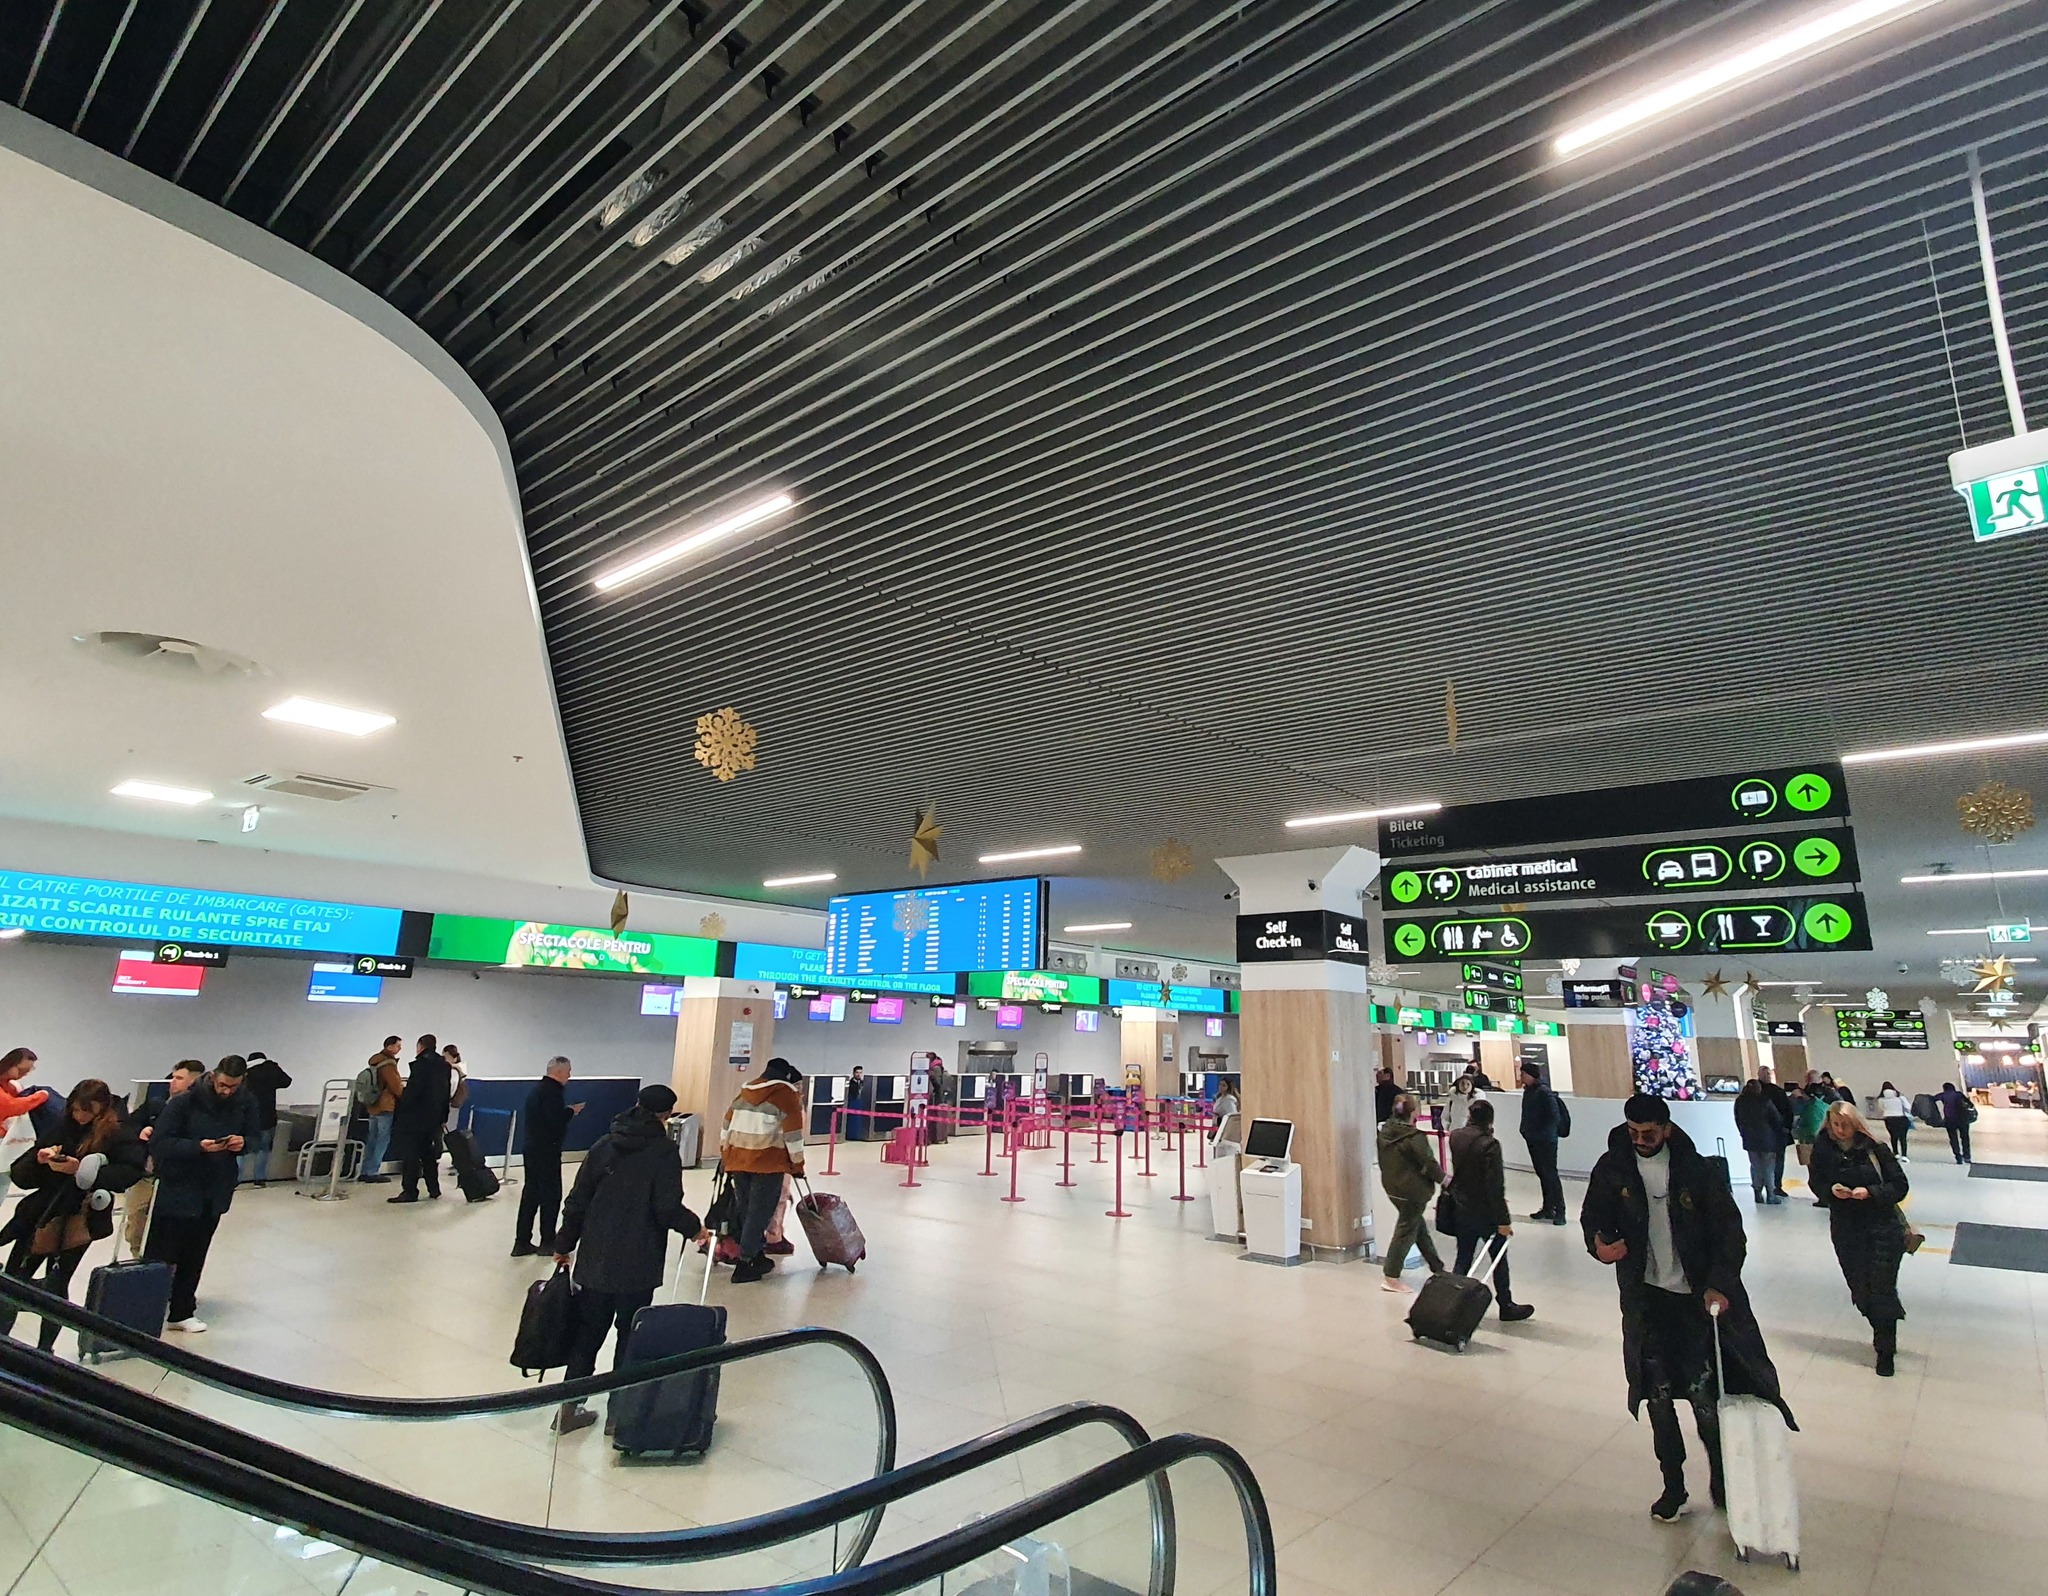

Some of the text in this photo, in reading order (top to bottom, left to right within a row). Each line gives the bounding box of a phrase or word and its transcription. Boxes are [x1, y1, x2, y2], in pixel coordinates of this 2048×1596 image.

[1390, 820, 1425, 833] Bilete
[1390, 834, 1445, 849] Ticketing
[1466, 858, 1578, 880] Cabinet medical
[1468, 877, 1596, 897] Medical assistance
[18, 878, 81, 895] CATRE
[166, 892, 191, 905] DE
[193, 894, 287, 914] IMBARCARE
[290, 903, 354, 921] (GATES):
[0, 894, 331, 933] IZATI SCARILE RULANTE SPRE ETAJ
[40, 915, 162, 936] CONTROLUL
[168, 926, 192, 938] DE
[197, 927, 304, 946] SECURITATE
[1265, 920, 1288, 934] Self
[519, 932, 651, 954] SPECTACOLE PENTRU
[1256, 935, 1302, 949] Check-in
[792, 950, 803, 960] TO
[799, 962, 826, 972] PLEAS
